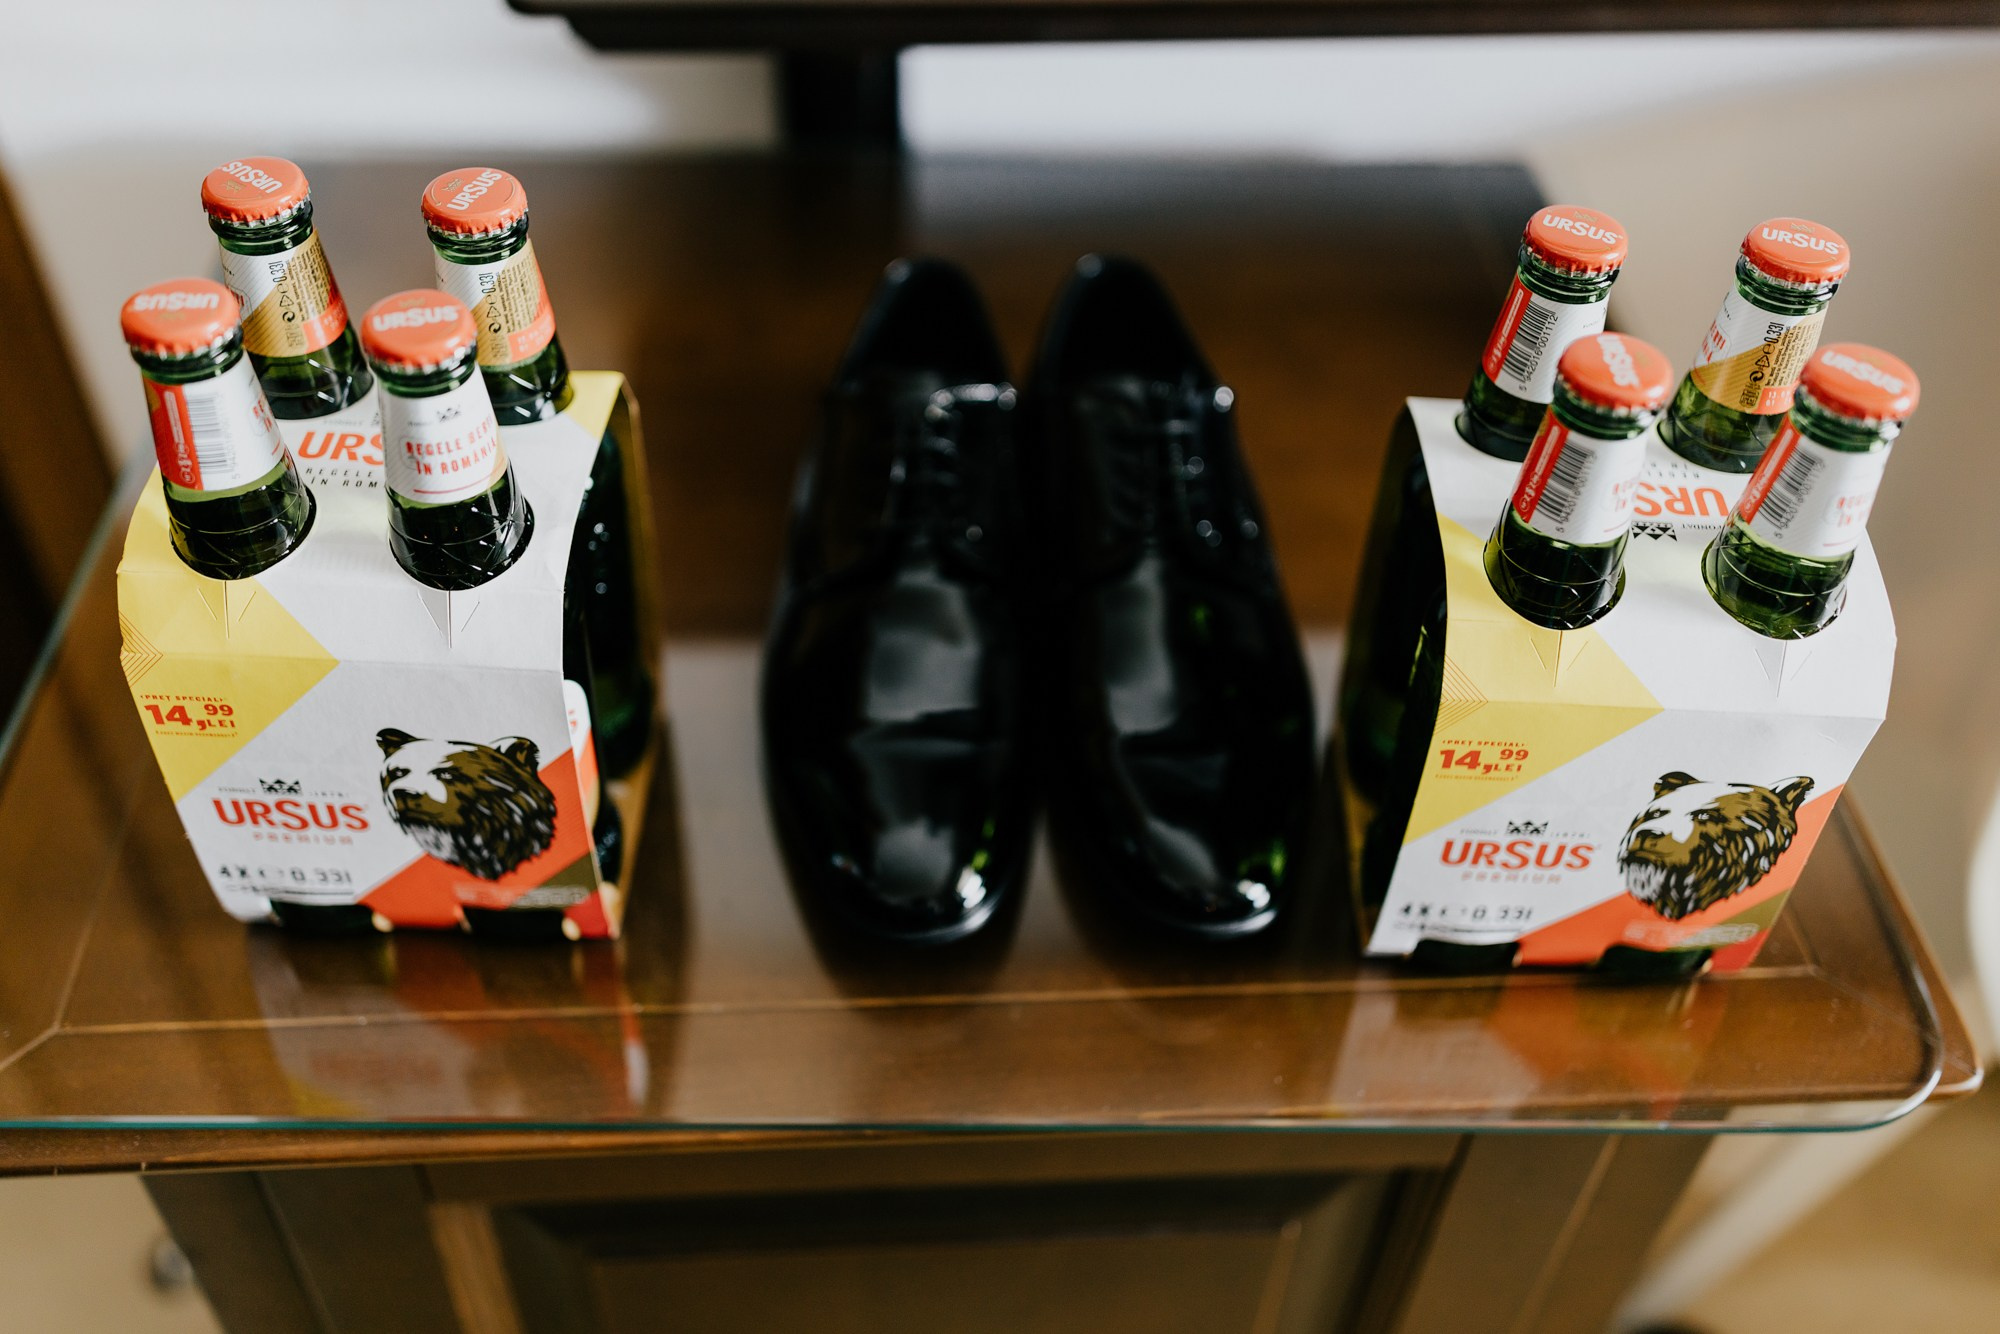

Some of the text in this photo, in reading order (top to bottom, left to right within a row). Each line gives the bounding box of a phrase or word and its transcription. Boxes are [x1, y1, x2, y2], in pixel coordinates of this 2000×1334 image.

[221, 161, 283, 194] URSUS
[446, 170, 503, 211] URSUS
[1542, 214, 1618, 245] URSUS
[1761, 227, 1840, 255] URSUS
[133, 291, 220, 311] URSUS
[372, 305, 459, 332] URSUS
[1596, 334, 1640, 387] URSUS
[1821, 350, 1905, 395] URSUS
[298, 431, 384, 466] URS
[1633, 481, 1730, 517] URS
[212, 798, 370, 831] URSUS
[1440, 839, 1594, 870] URSUS
